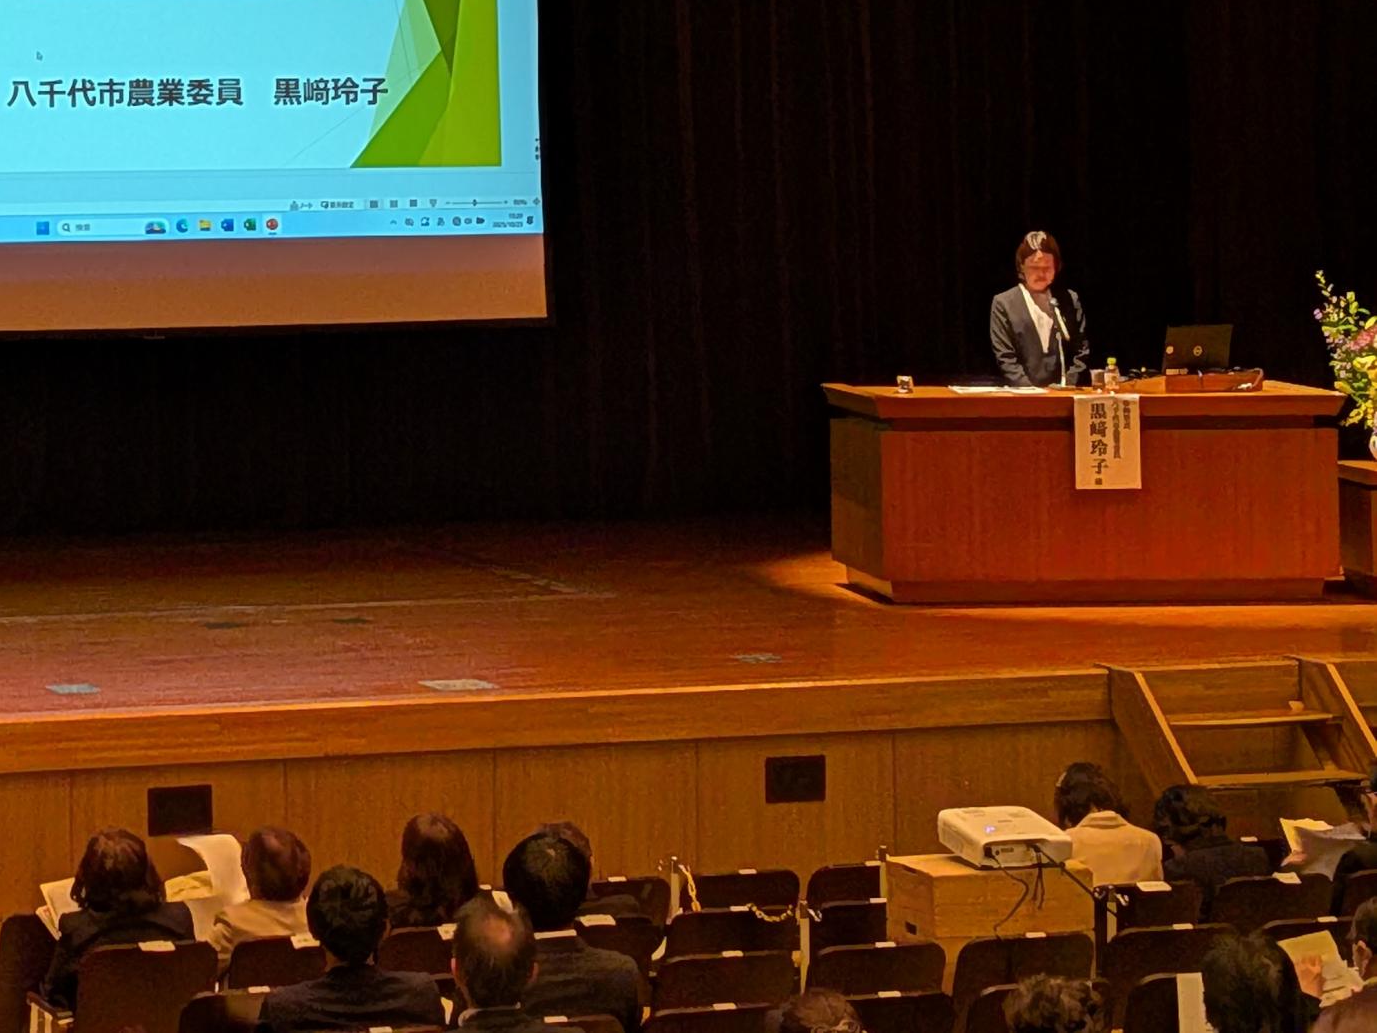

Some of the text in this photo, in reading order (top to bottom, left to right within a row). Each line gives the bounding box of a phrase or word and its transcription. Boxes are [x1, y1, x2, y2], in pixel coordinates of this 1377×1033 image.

[7, 79, 244, 108] 八千代市農業委員
